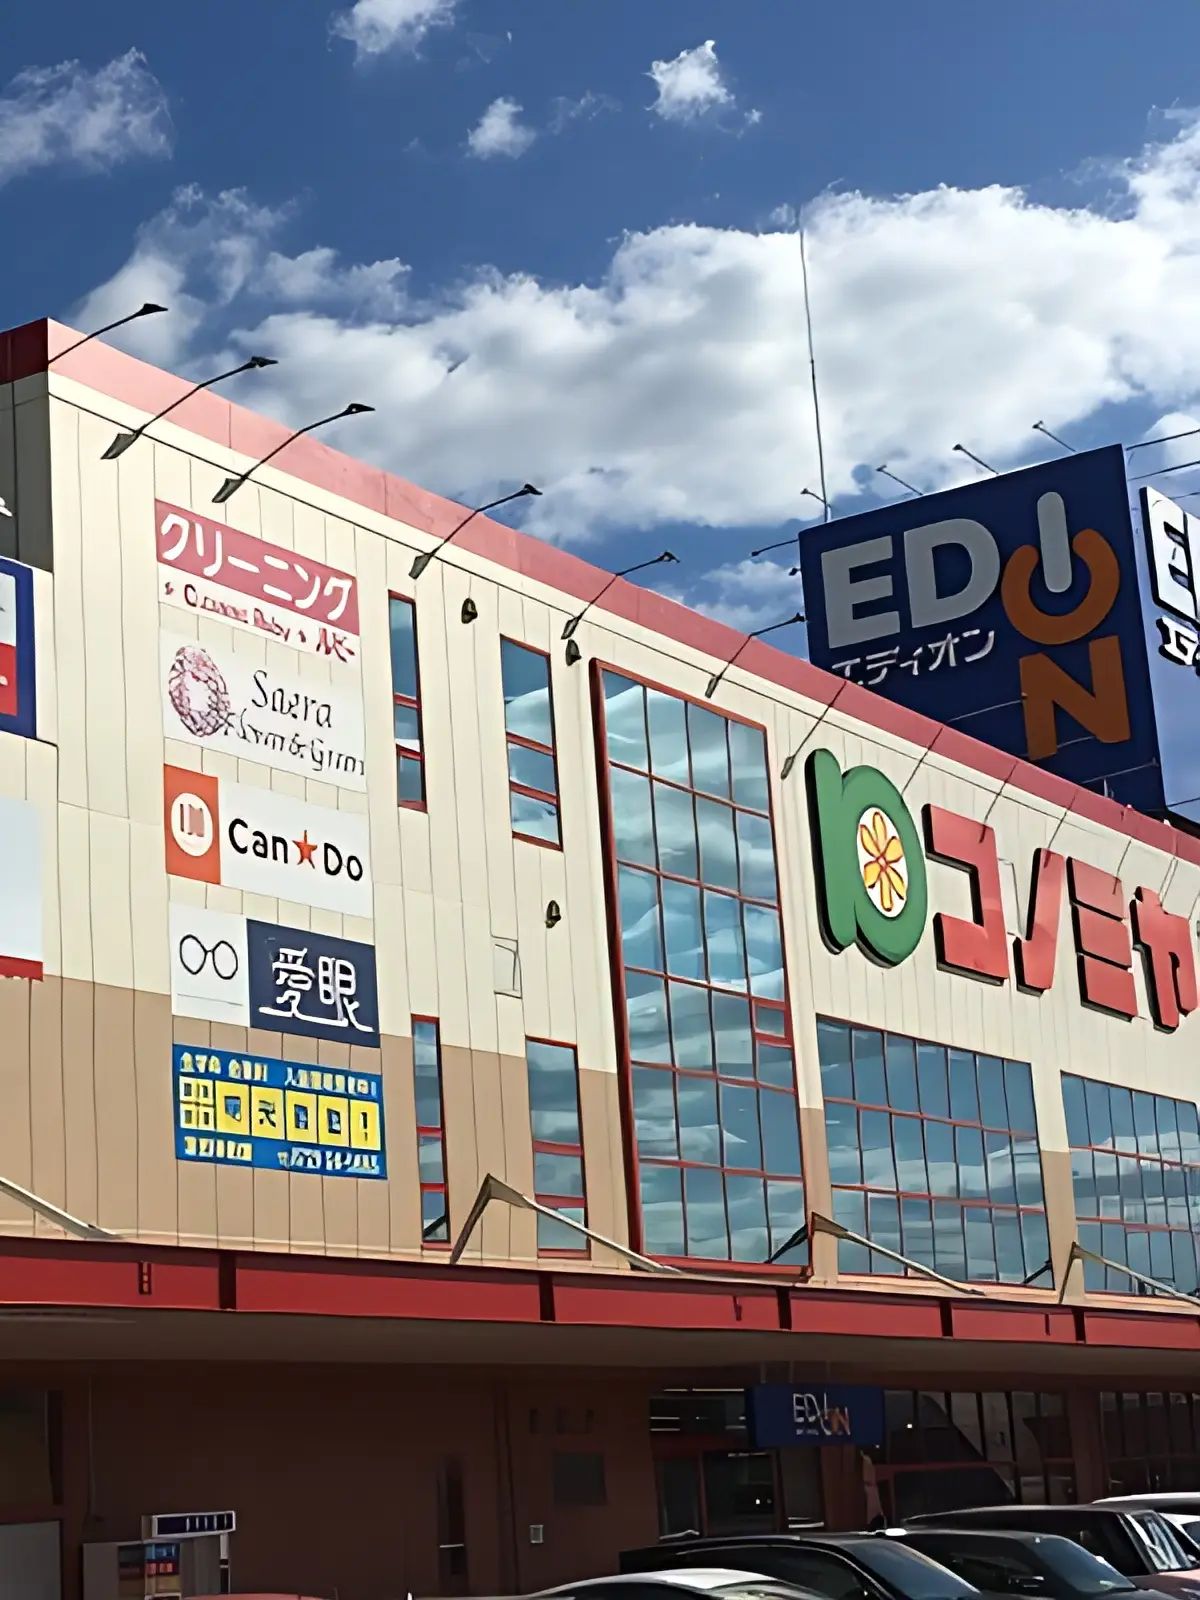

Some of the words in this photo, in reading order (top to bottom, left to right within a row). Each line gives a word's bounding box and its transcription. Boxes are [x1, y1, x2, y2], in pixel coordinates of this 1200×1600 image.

[820, 491, 1131, 761] EDION
[258, 947, 375, 1033] 愛眼
[922, 803, 1199, 1034] コノミヤ
